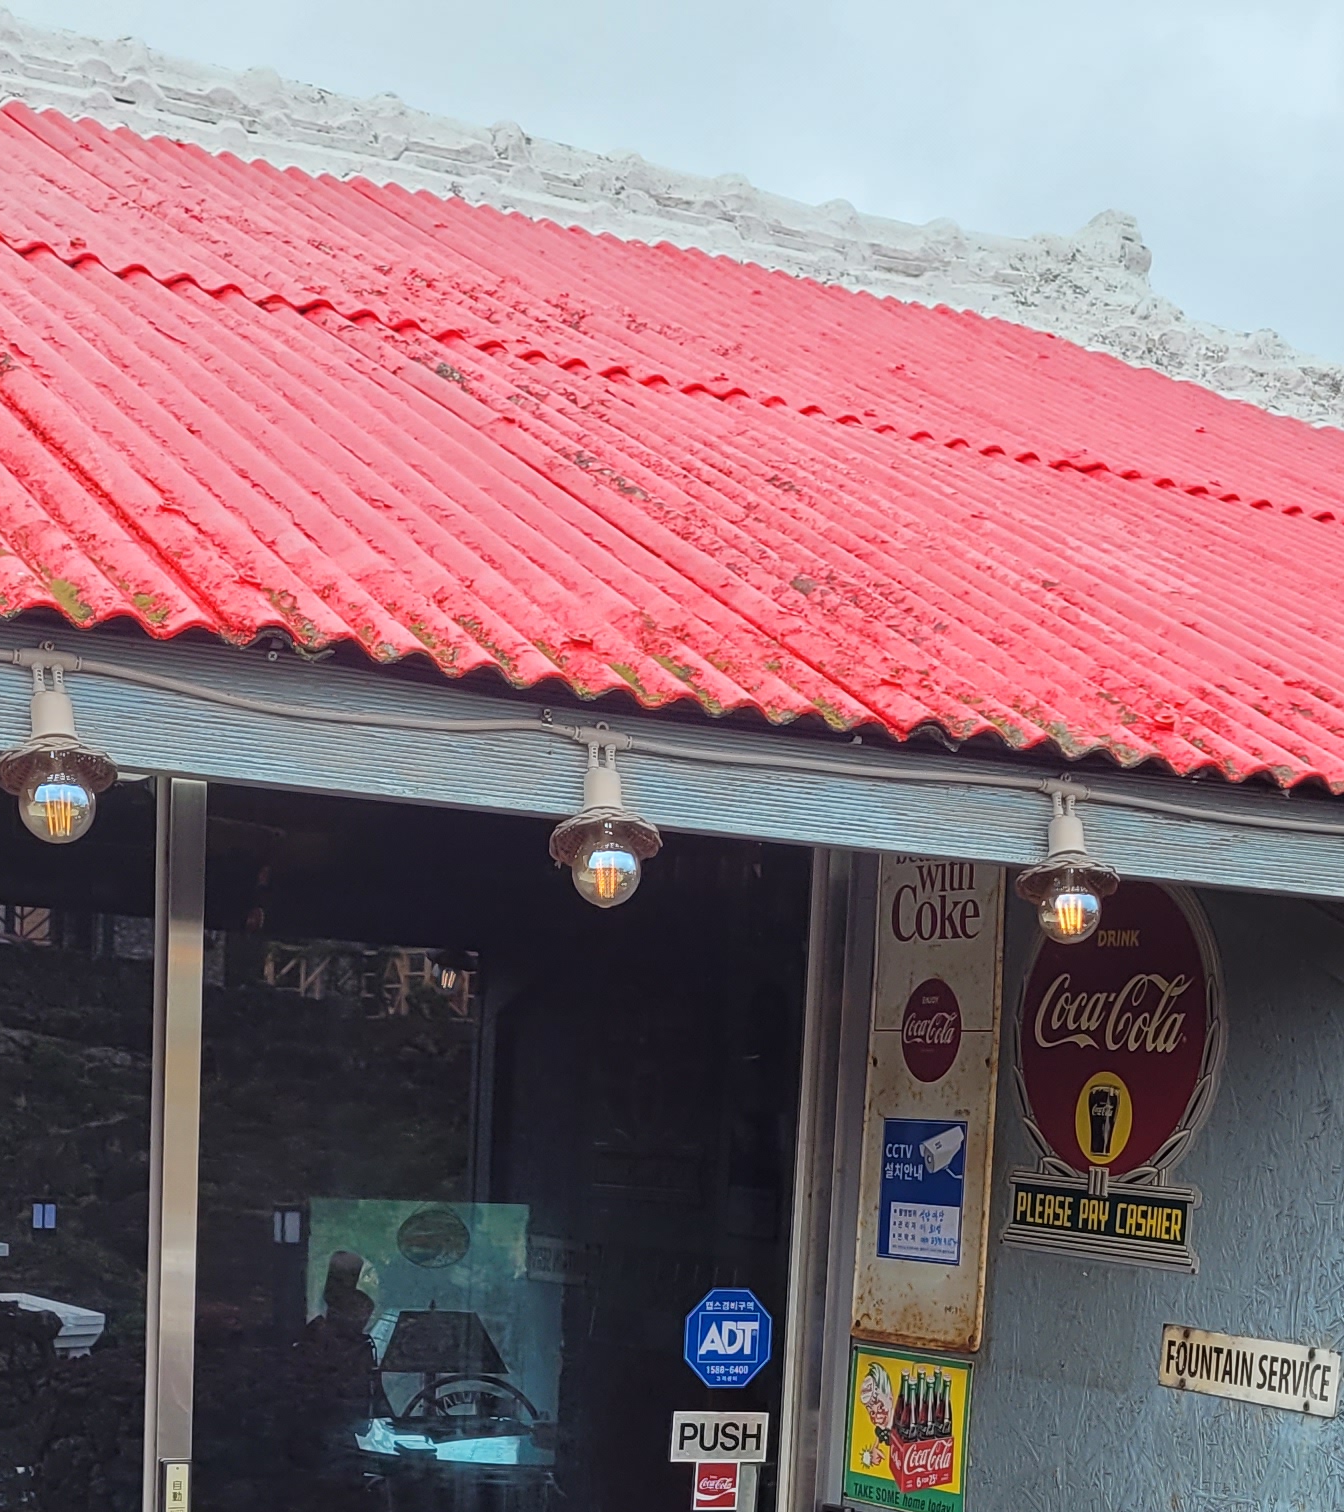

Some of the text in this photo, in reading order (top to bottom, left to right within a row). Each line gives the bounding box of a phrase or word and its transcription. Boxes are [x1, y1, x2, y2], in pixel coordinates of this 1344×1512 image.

[916, 862, 976, 893] with
[892, 884, 980, 942] Coke
[1098, 930, 1141, 948] DRINK
[903, 1012, 957, 1044] Coca-Cola
[1035, 973, 1194, 1053] Coca-Cola
[885, 1143, 913, 1159] CCTV
[884, 1162, 924, 1182] 설치안내
[1016, 1191, 1182, 1241] PLEASE PAY CASHIER
[699, 1321, 759, 1355] ADT
[1165, 1340, 1331, 1402] FOUNTAIN SERVICE
[679, 1422, 762, 1451] PUSH
[904, 1439, 952, 1475] Coca-Cola
[854, 1483, 873, 1499] TAKE
[876, 1489, 900, 1505] SOME
[902, 1493, 925, 1511] home
